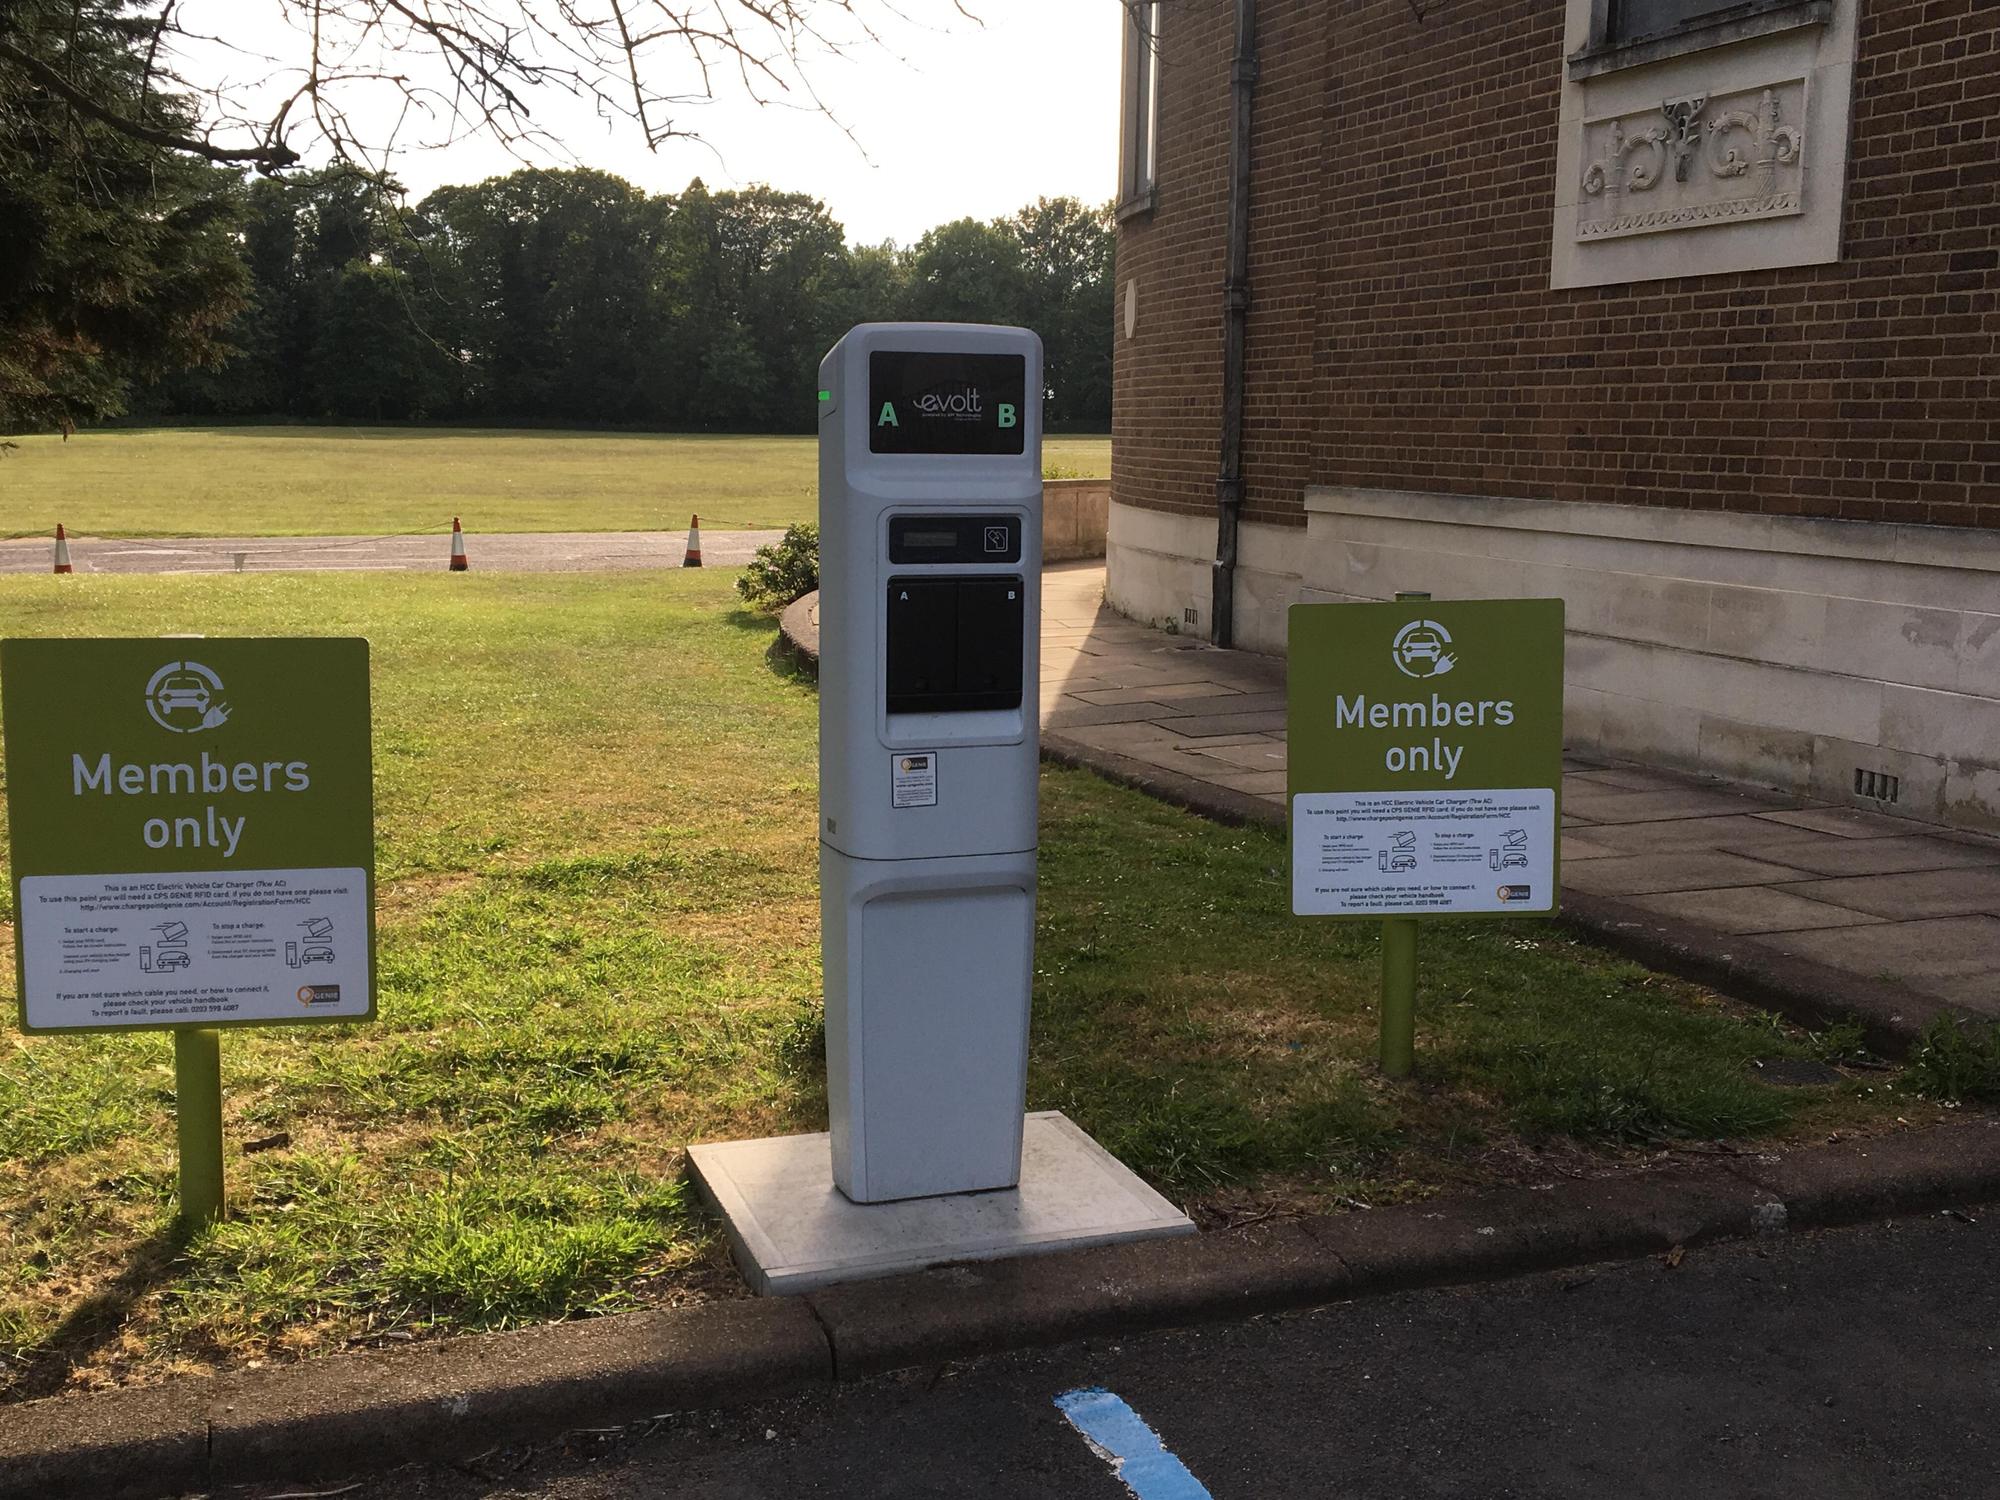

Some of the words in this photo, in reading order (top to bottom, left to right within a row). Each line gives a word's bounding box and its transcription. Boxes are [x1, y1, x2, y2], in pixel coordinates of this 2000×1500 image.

[913, 388, 982, 412] evolt
[877, 402, 899, 426] A
[998, 403, 1016, 428] B
[900, 591, 908, 600] A
[1007, 591, 1015, 600] B
[1336, 693, 1514, 729] Members
[1385, 737, 1464, 780] only
[72, 752, 310, 795] Members
[143, 806, 246, 857] only
[104, 884, 119, 892] This
[140, 883, 155, 891] HCC
[157, 883, 183, 891] Electric
[184, 882, 210, 890] Vehicle
[225, 881, 254, 890] Charger
[39, 895, 47, 903] To
[64, 895, 77, 903] this
[79, 894, 97, 903] point
[99, 895, 112, 903] you
[113, 893, 126, 901] will
[128, 893, 145, 901] need
[153, 892, 169, 900] CPS
[169, 891, 193, 900] GENIE
[253, 889, 262, 897] do
[308, 888, 332, 897] please
[62, 993, 76, 1001] you
[91, 991, 103, 999] not
[121, 990, 143, 998] which
[144, 989, 164, 997] cable
[234, 985, 262, 993] connect
[315, 991, 339, 1000] GENIE
[102, 1000, 126, 1008] please
[150, 999, 166, 1007] your
[168, 997, 193, 1005] vehicle
[91, 1009, 99, 1017] To
[101, 1009, 123, 1017] report
[150, 1007, 173, 1016] please
